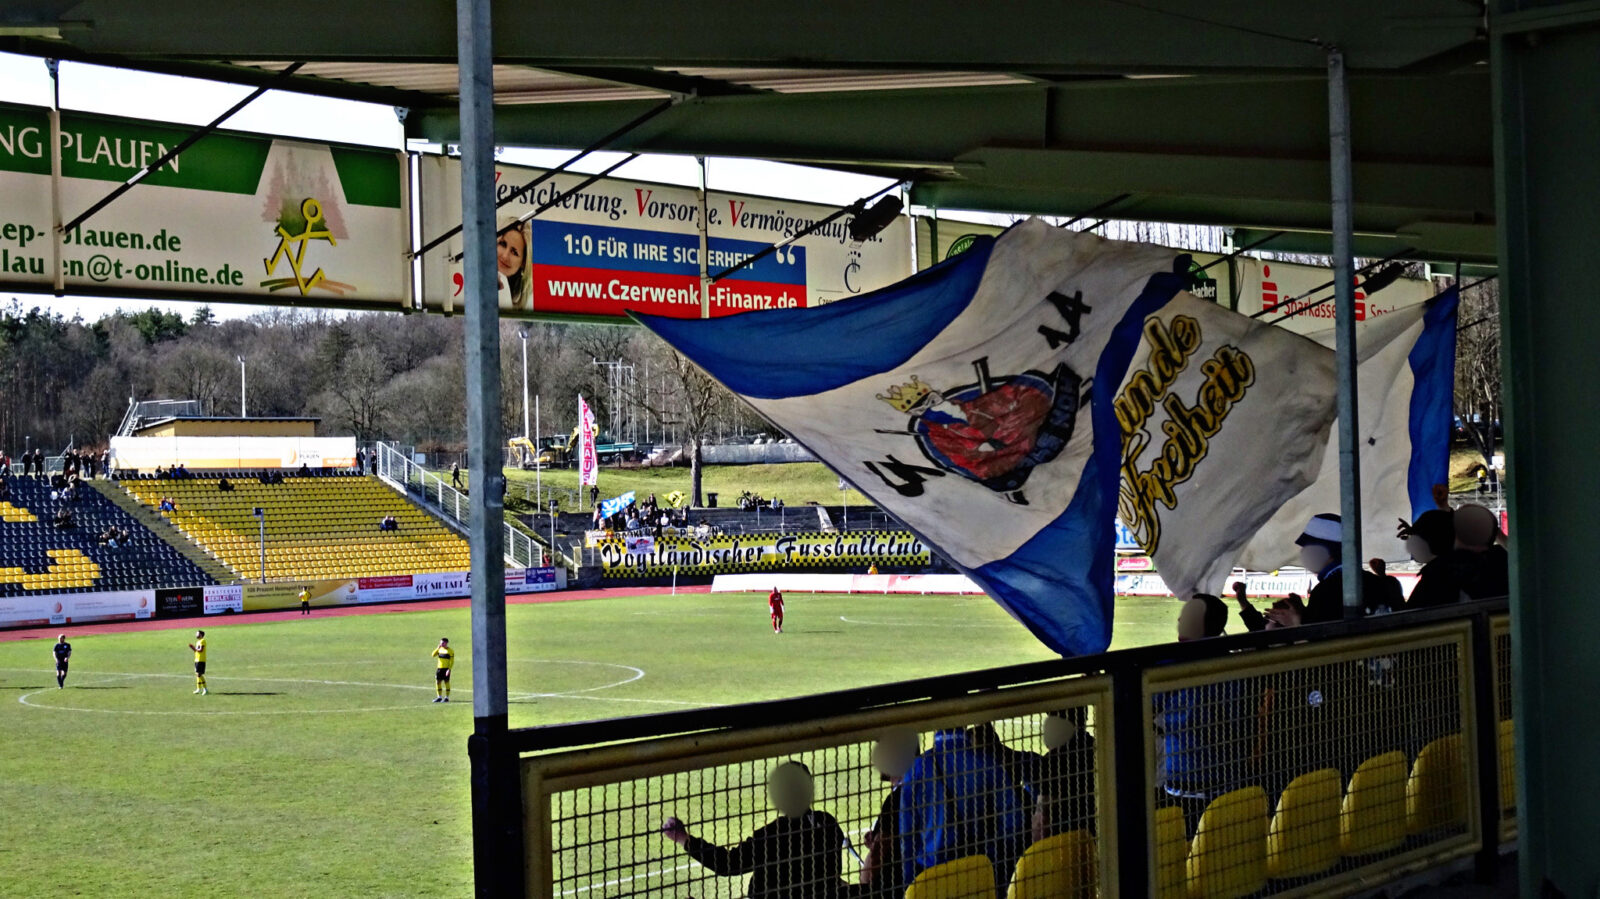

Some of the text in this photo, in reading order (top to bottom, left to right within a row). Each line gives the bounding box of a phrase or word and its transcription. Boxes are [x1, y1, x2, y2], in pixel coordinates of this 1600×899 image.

[494, 171, 628, 221] ersicherung.
[563, 233, 593, 255] 1:0
[598, 237, 628, 259] FÜR
[633, 245, 667, 261] IHRE
[548, 279, 798, 310] www.Czerwenk-Finanz.de
[602, 535, 923, 574] Vogtländischer Fussballclub
